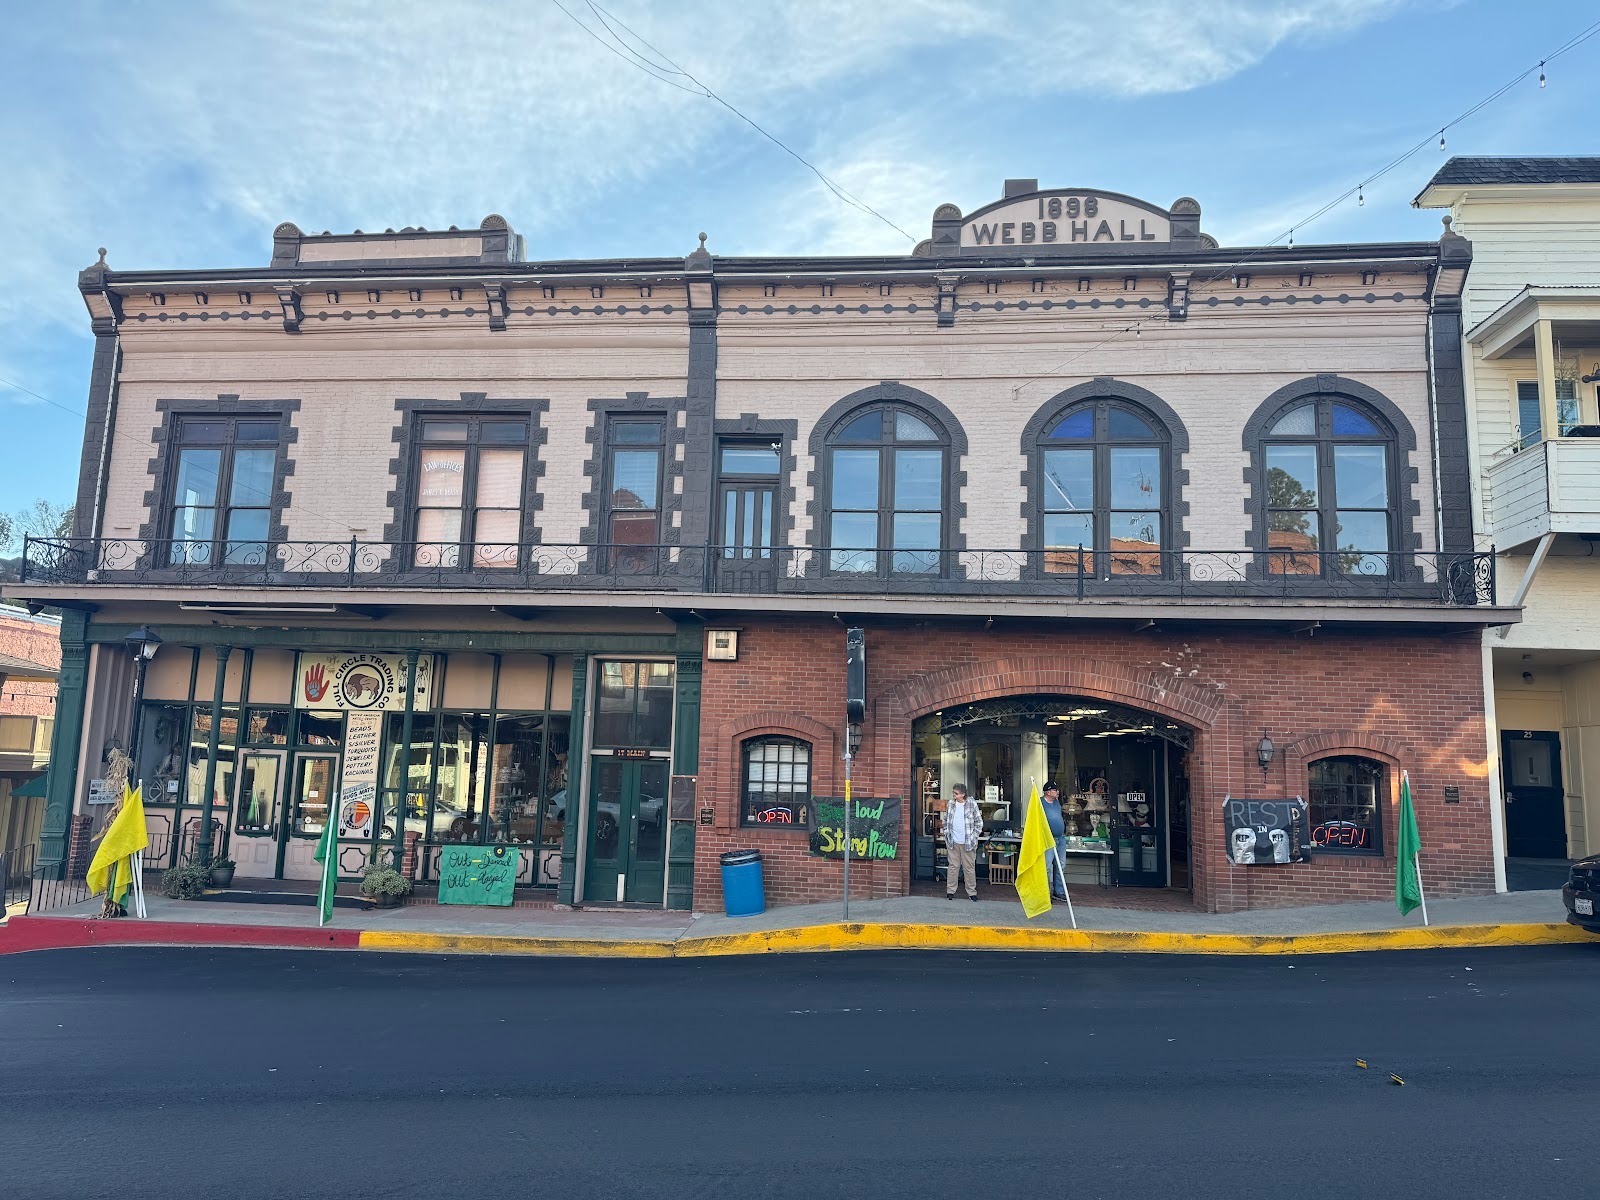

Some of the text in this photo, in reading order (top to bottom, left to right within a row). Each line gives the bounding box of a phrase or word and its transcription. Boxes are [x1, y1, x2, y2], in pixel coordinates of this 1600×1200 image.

[1038, 196, 1099, 219] 1898
[972, 219, 1156, 245] WEBB HALL
[424, 460, 463, 474] LAW OFFICES
[335, 654, 367, 680] CIRCLE
[369, 654, 394, 693] TRADING
[333, 682, 345, 708] FULL
[350, 725, 372, 733] BEADS
[1523, 731, 1533, 739] 25
[348, 732, 377, 740] LEATHER
[347, 746, 377, 754] TURQUOISE
[345, 761, 373, 769] POTTERY
[344, 768, 374, 777] KACHINAS
[1128, 793, 1145, 801] OPEN
[855, 800, 885, 820] loud
[1229, 800, 1298, 828] REST
[757, 811, 792, 824] OPEN
[1256, 825, 1268, 834] IN
[1312, 826, 1366, 845] OPEN
[868, 828, 898, 860] Proud
[1235, 833, 1250, 842] RIP
